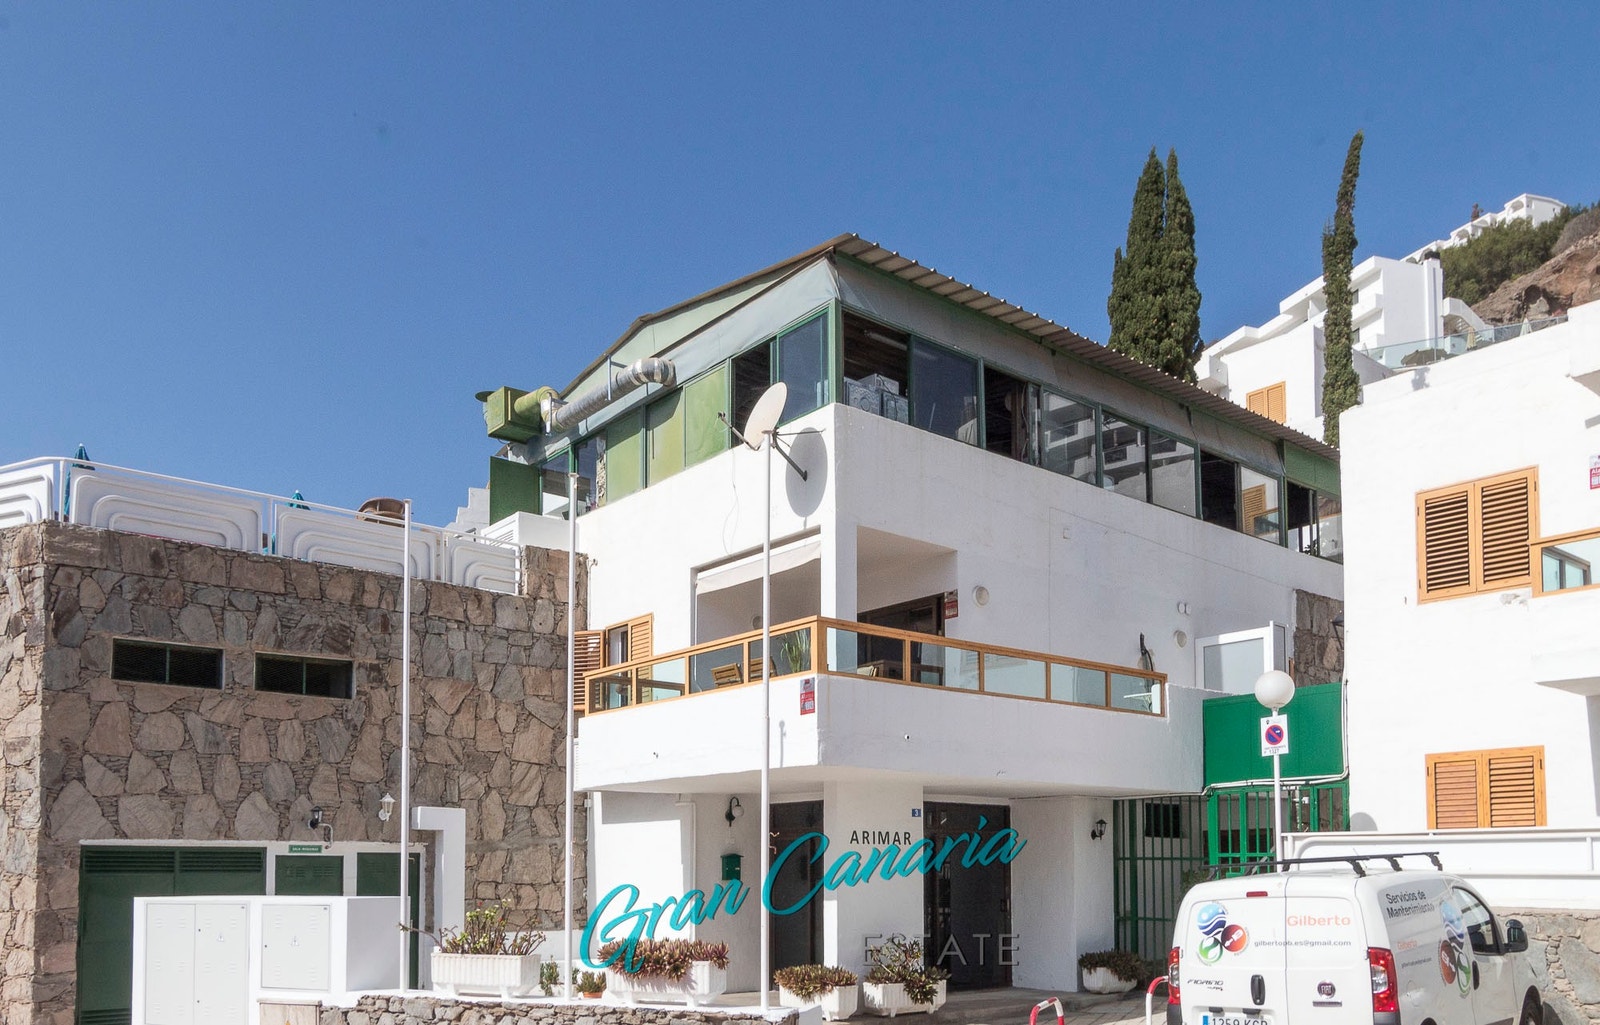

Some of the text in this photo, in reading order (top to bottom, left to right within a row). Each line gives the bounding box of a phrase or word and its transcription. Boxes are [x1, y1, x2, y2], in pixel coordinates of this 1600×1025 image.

[850, 830, 912, 846] ARIMAR
[1385, 890, 1427, 905] Servicios de
[1386, 903, 1436, 919] Mantenimiento
[1286, 915, 1352, 928] Gilberto
[1320, 985, 1332, 995] FIAT
